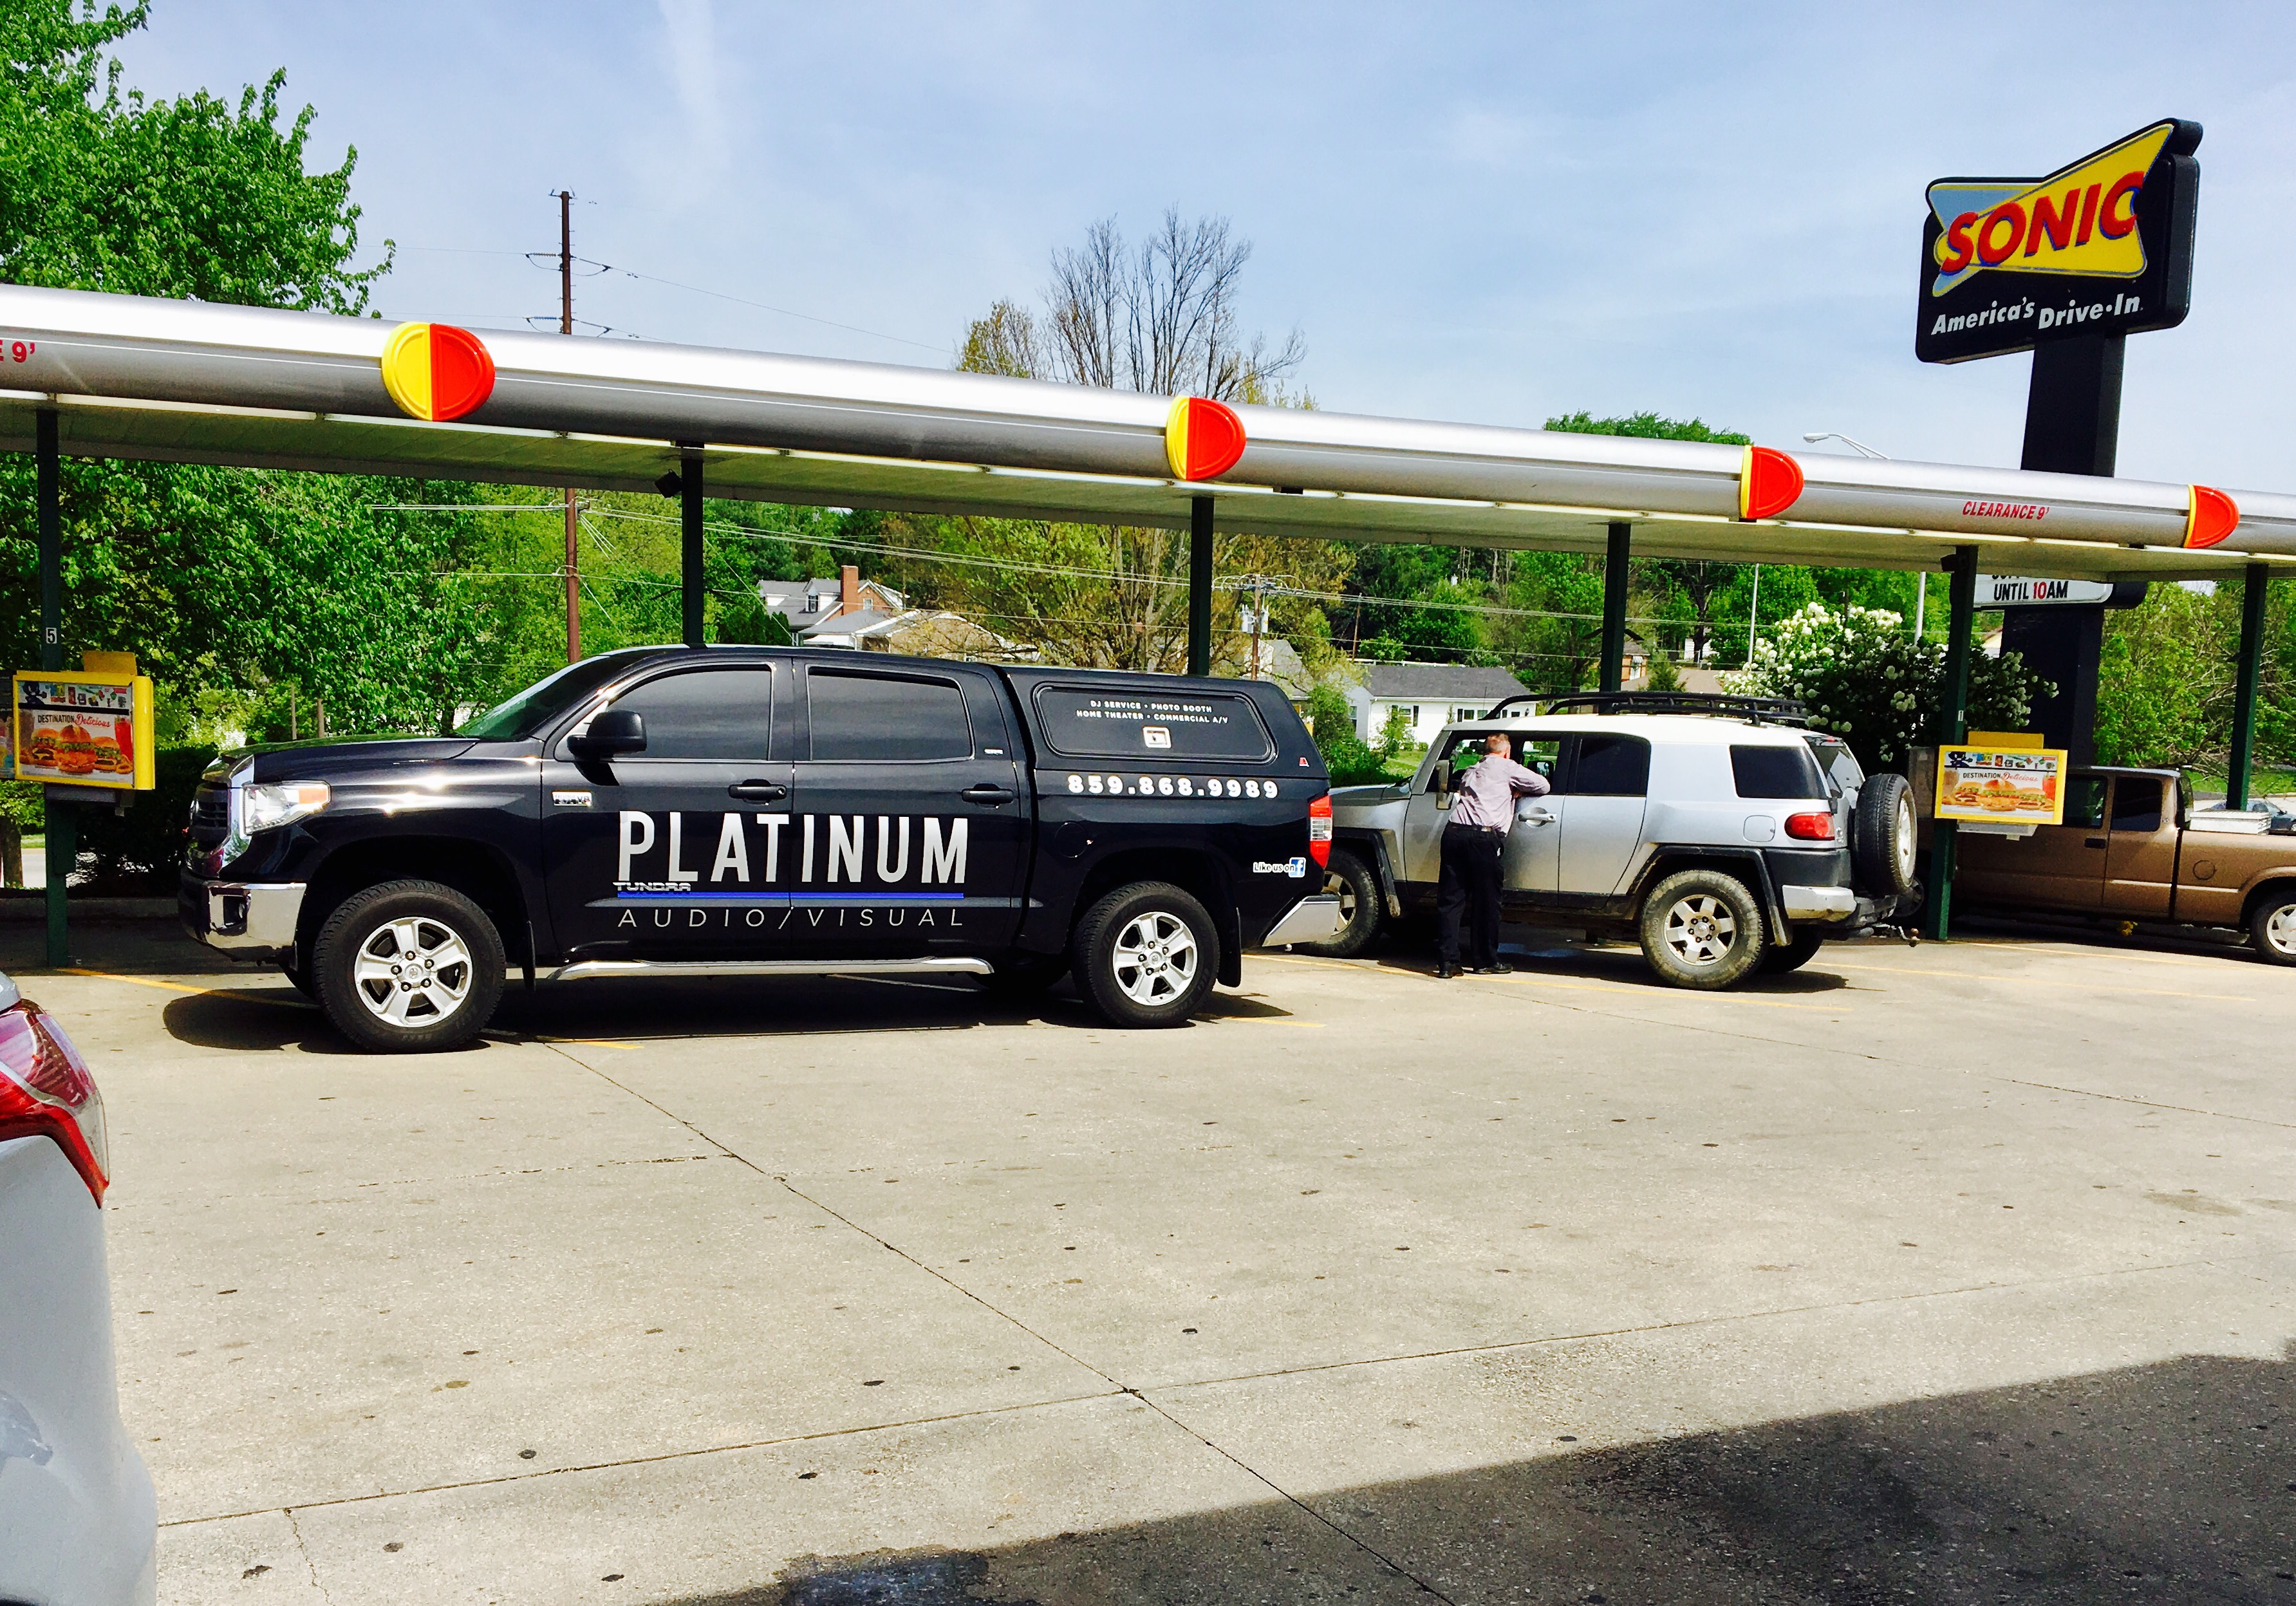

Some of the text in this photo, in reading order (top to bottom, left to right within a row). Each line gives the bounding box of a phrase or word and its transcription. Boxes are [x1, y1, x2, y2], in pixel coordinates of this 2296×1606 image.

[1939, 171, 2144, 275] SONIC
[1931, 297, 2035, 335] America's
[12, 341, 35, 363] 9'
[1962, 500, 2049, 520] CLEARANCE 9'
[1993, 581, 2069, 601] UNTIL 10AM
[47, 628, 55, 643] 5
[1076, 709, 1228, 724] HOME THEATER COMMERCIAL A/V
[1090, 700, 1212, 713] DJ SERVICE PHOTO BOOTH
[37, 713, 111, 728] DESTINATION Delicious
[1067, 774, 1278, 799] 859.868.9989
[2001, 772, 2039, 782] Delicious
[617, 810, 969, 884] PLATINUM
[1254, 863, 1271, 872] Like
[612, 882, 691, 892] TUNDRA
[617, 908, 964, 929] AUDIO/VISUAL
